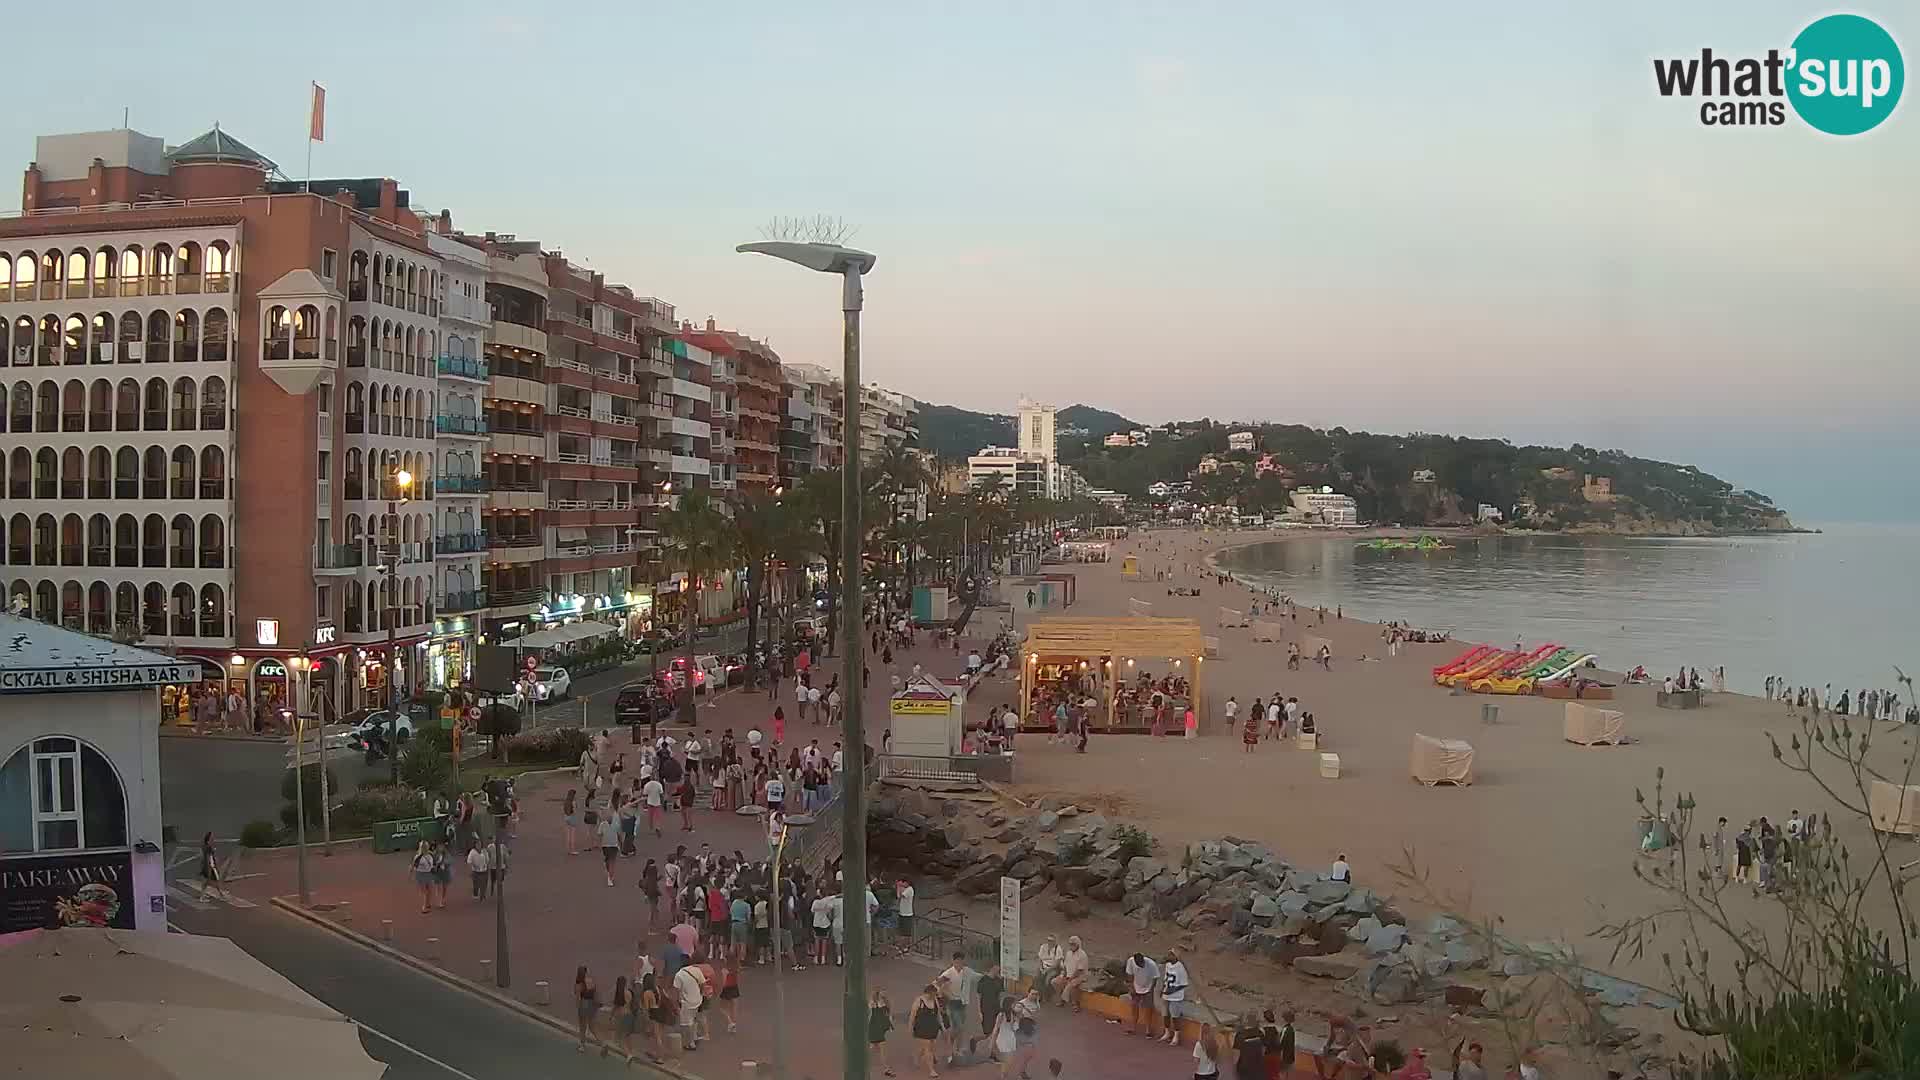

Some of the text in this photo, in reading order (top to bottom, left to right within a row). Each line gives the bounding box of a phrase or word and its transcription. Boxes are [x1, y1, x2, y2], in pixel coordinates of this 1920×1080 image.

[316, 627, 335, 644] KFC
[0, 666, 181, 687] CKTAIL & SHISHA BAR
[260, 665, 285, 675] KFC
